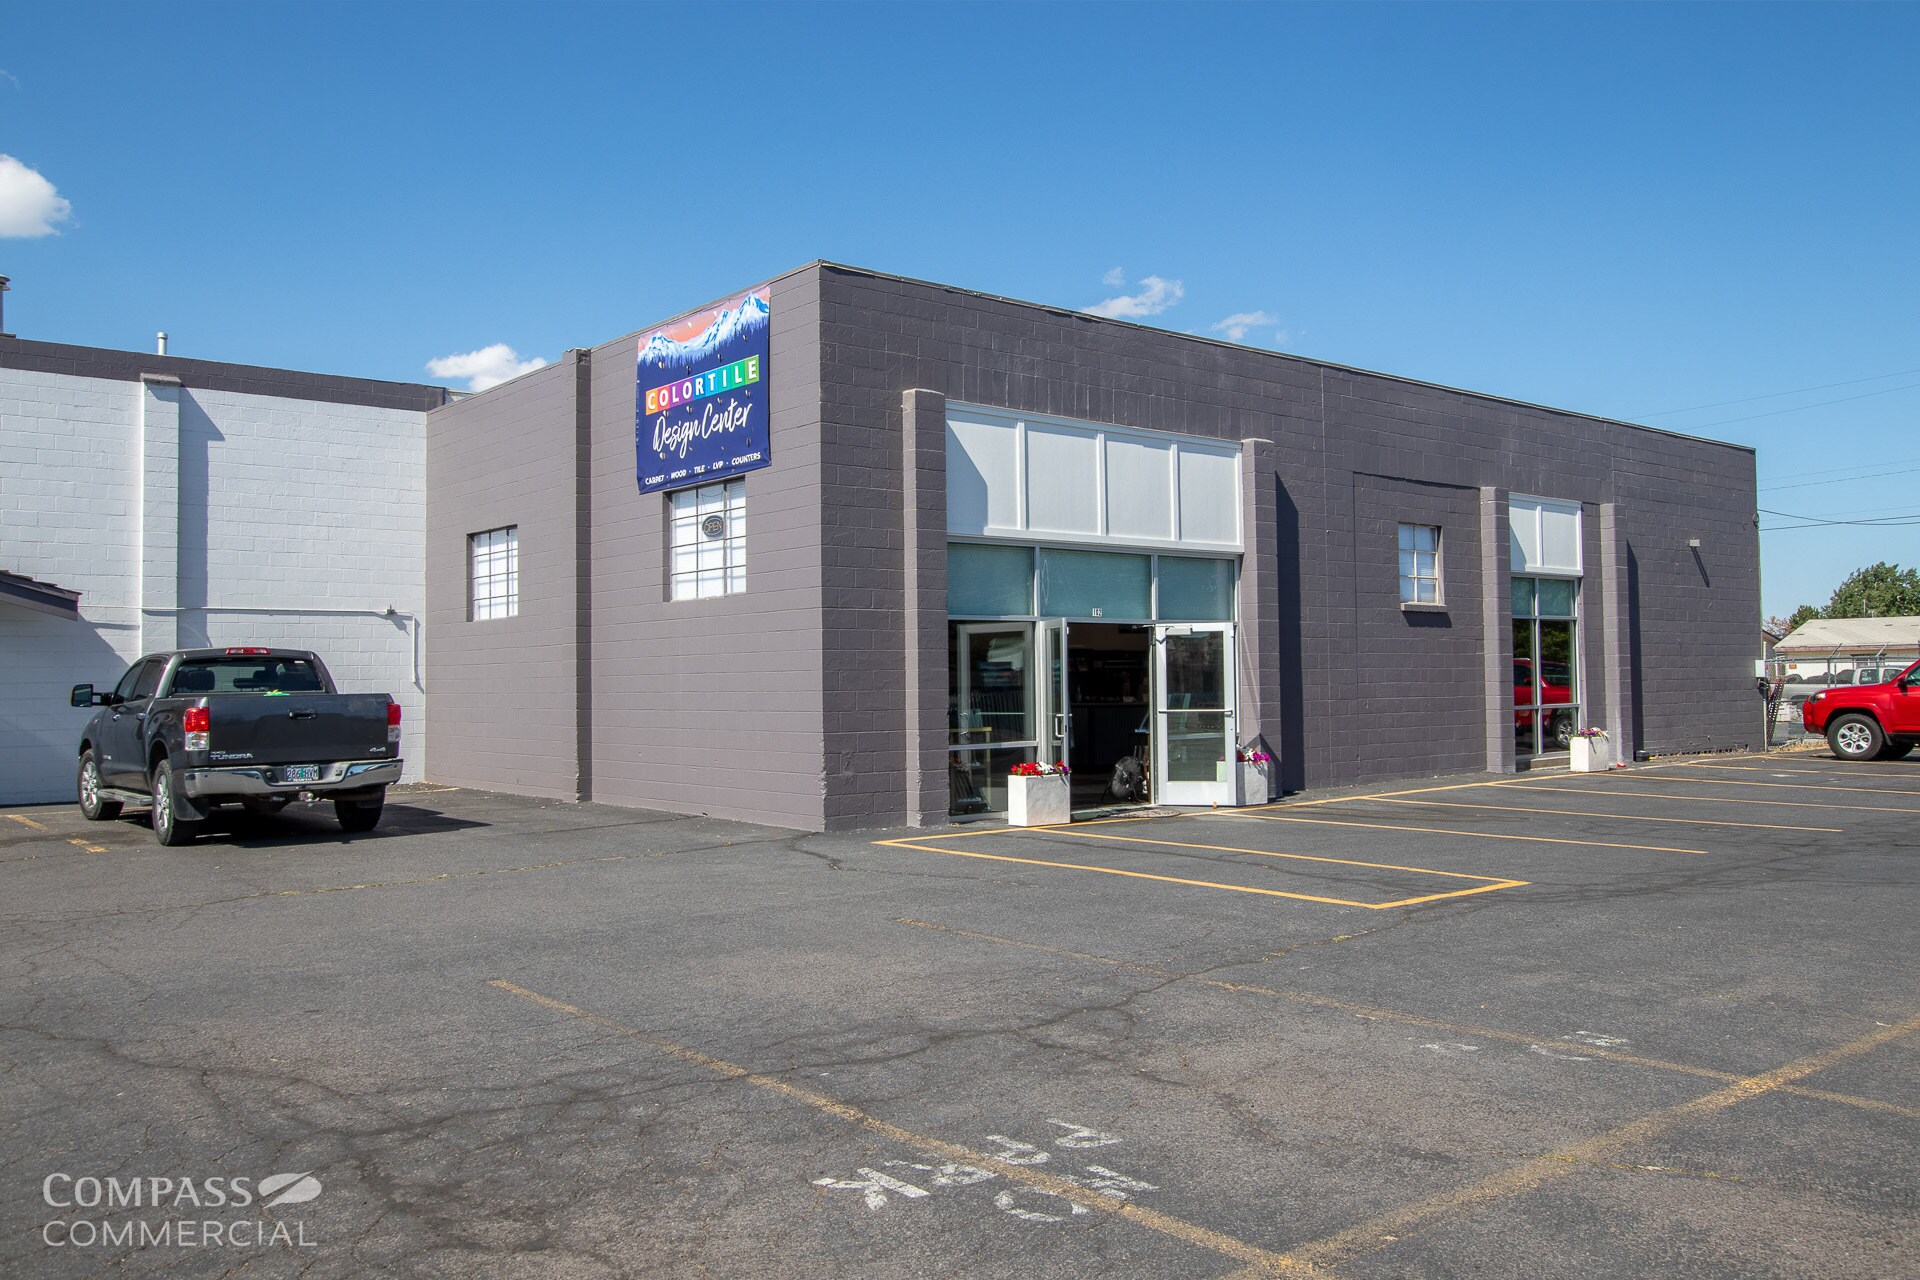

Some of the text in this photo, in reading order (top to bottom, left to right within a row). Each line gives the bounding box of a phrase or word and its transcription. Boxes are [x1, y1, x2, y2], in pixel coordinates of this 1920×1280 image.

[646, 359, 758, 411] COLORTILE
[652, 398, 753, 459] Design Center
[645, 452, 761, 485] CARPET WOOD TILE LVP COUNTERS
[703, 521, 722, 533] OPEN
